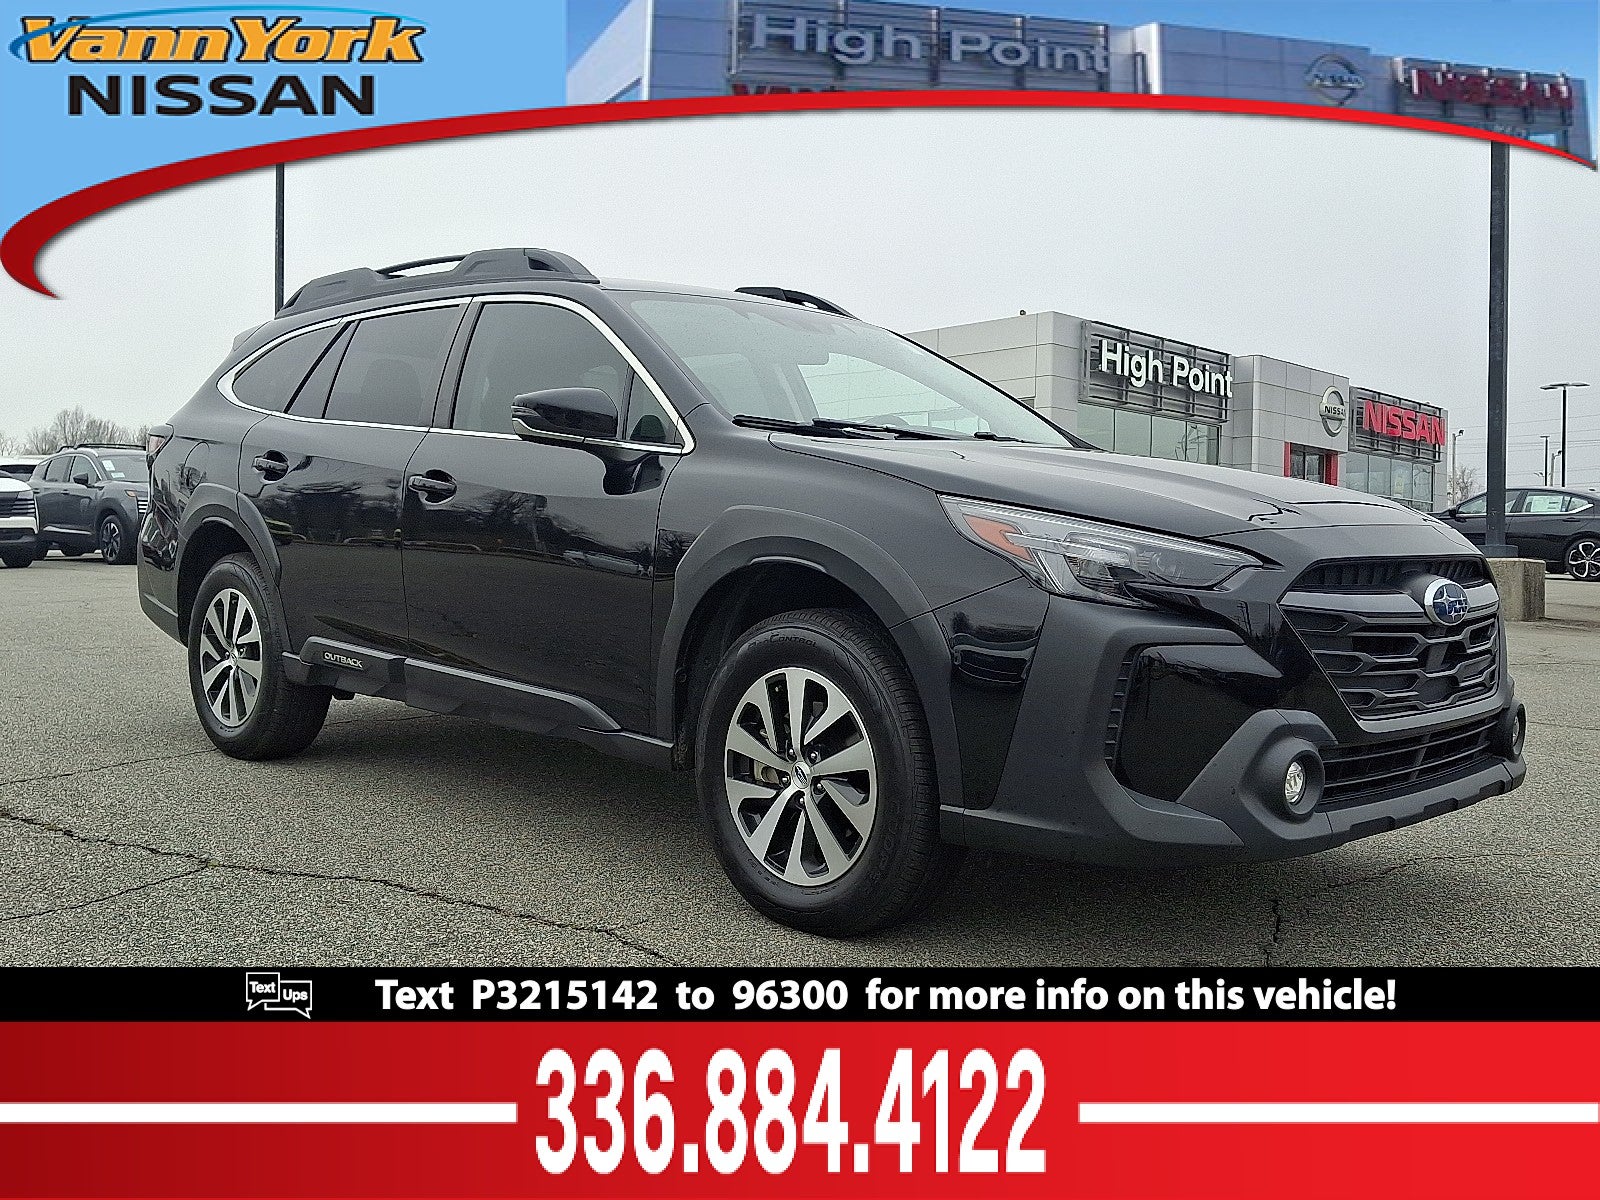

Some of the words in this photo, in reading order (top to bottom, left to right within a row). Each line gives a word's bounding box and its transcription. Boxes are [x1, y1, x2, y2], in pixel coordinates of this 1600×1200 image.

[1100, 339, 1164, 388] High
[1172, 355, 1233, 398] Point
[1363, 399, 1446, 447] NISSAN
[324, 651, 363, 668] OUTBACK
